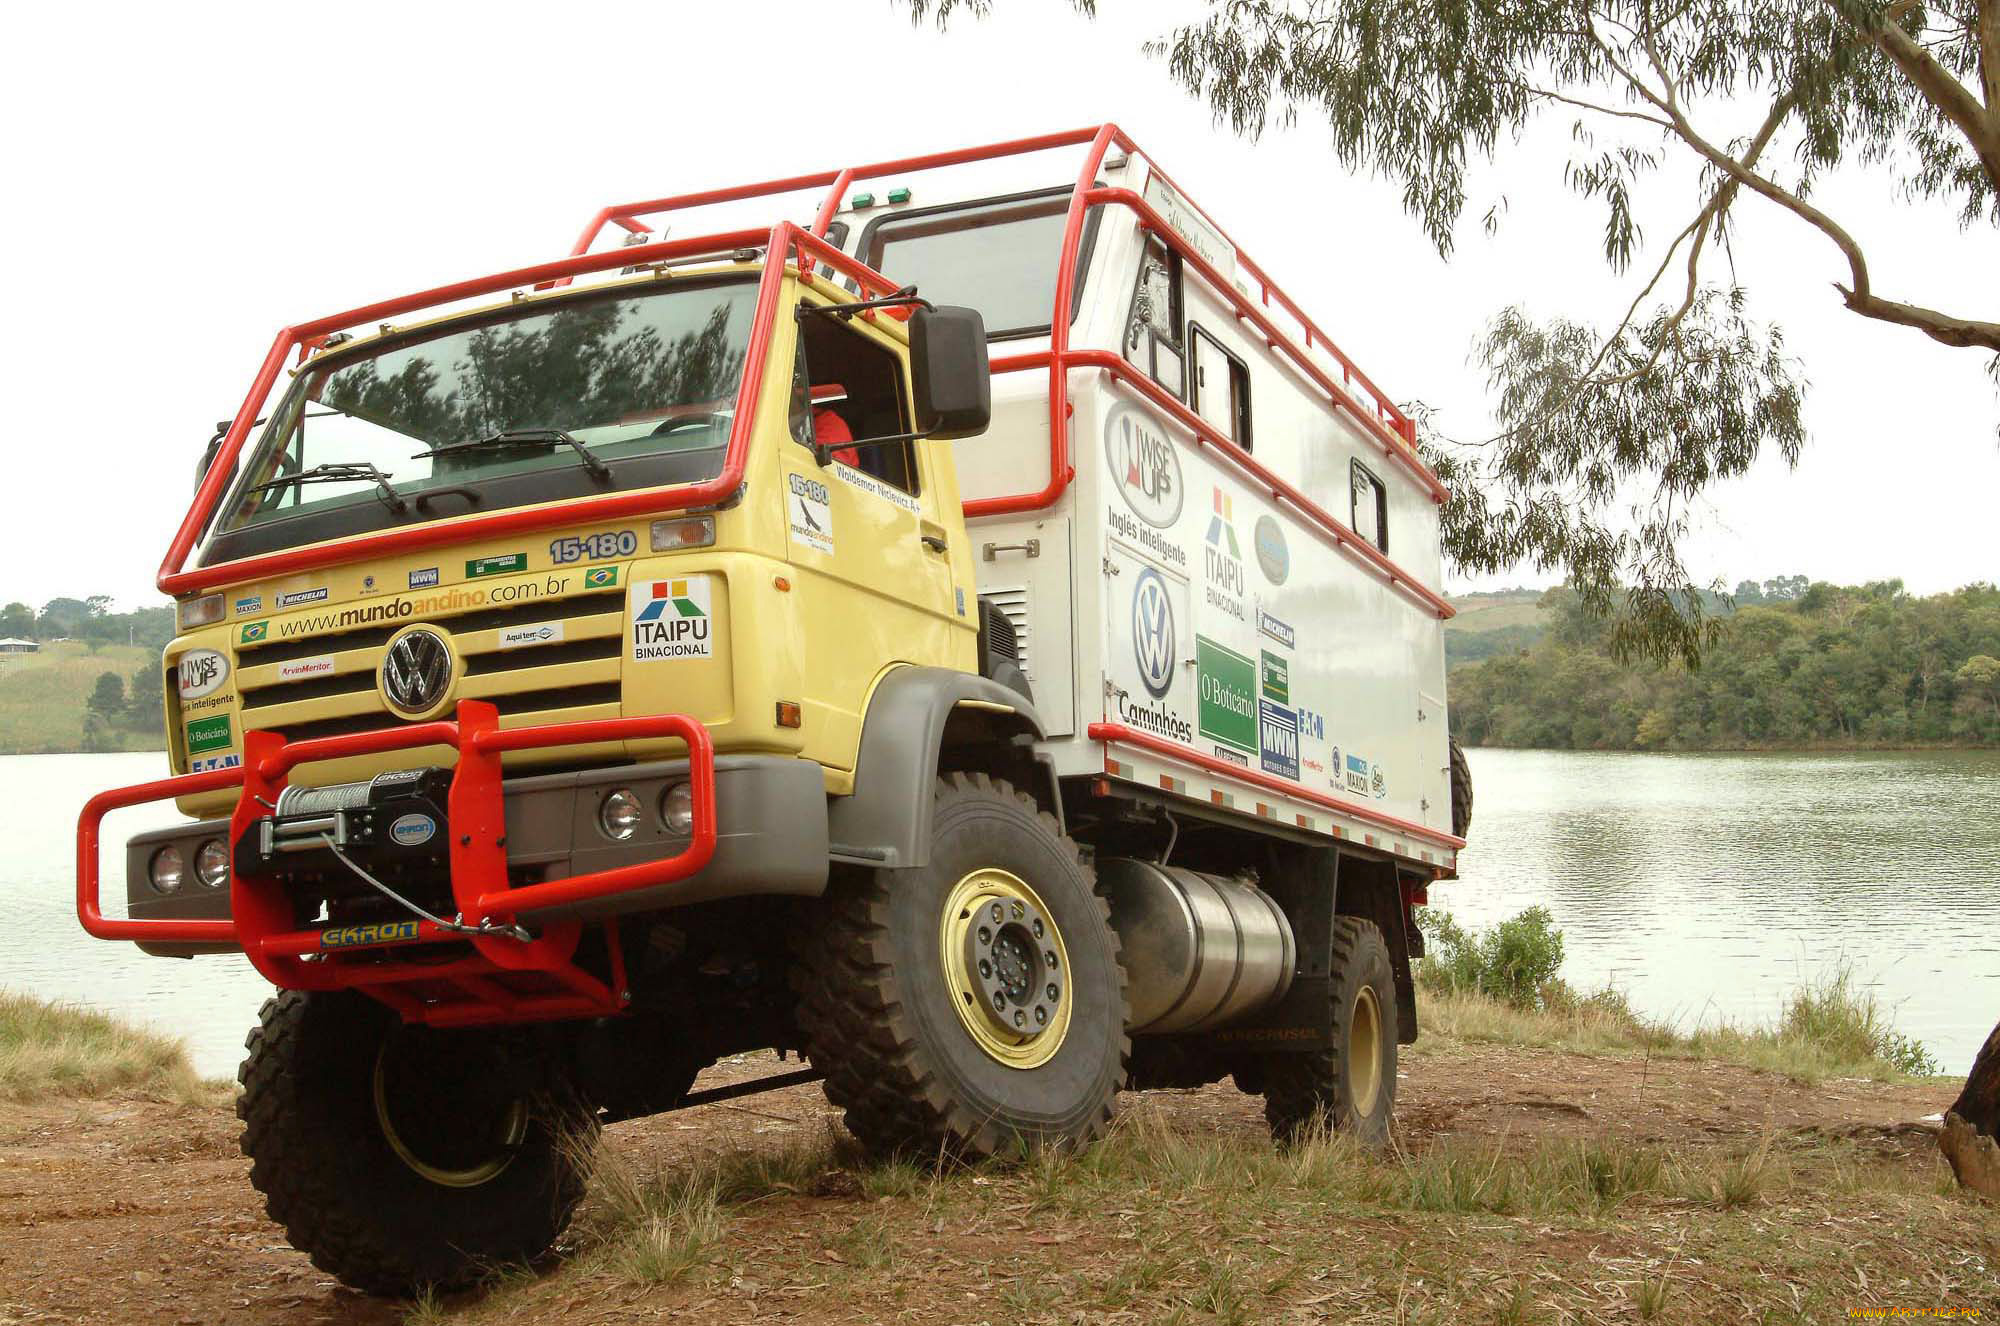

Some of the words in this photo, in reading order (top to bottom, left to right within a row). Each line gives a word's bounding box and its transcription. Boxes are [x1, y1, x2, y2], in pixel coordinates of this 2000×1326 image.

[1140, 428, 1170, 476] WISE
[789, 473, 830, 506] 15-180
[836, 465, 876, 493] Waldemar
[1141, 461, 1171, 504] UP
[550, 531, 637, 564] 15-180
[1140, 523, 1186, 565] inteligente
[411, 572, 437, 585] MWM
[1205, 545, 1244, 597] ITAIPU
[236, 602, 262, 615] MAXION
[280, 576, 570, 636] www.mundoandino.com.br
[285, 589, 327, 604] MICHELIN
[506, 632, 522, 642] Aqui
[635, 619, 708, 645] ITAIPU
[1264, 617, 1293, 644] MICHELIN
[190, 655, 217, 674] WISE
[635, 645, 708, 659] BINACIONAL
[190, 671, 217, 687] UP
[282, 661, 331, 676] ArvinMeritor
[192, 694, 234, 710] inteligente
[1202, 674, 1211, 700] O
[1213, 678, 1254, 719] Boticário
[1119, 692, 1192, 744] Caminhões
[197, 726, 228, 742] Boticário
[1263, 721, 1297, 760] MWM
[1347, 771, 1369, 793] MAXION
